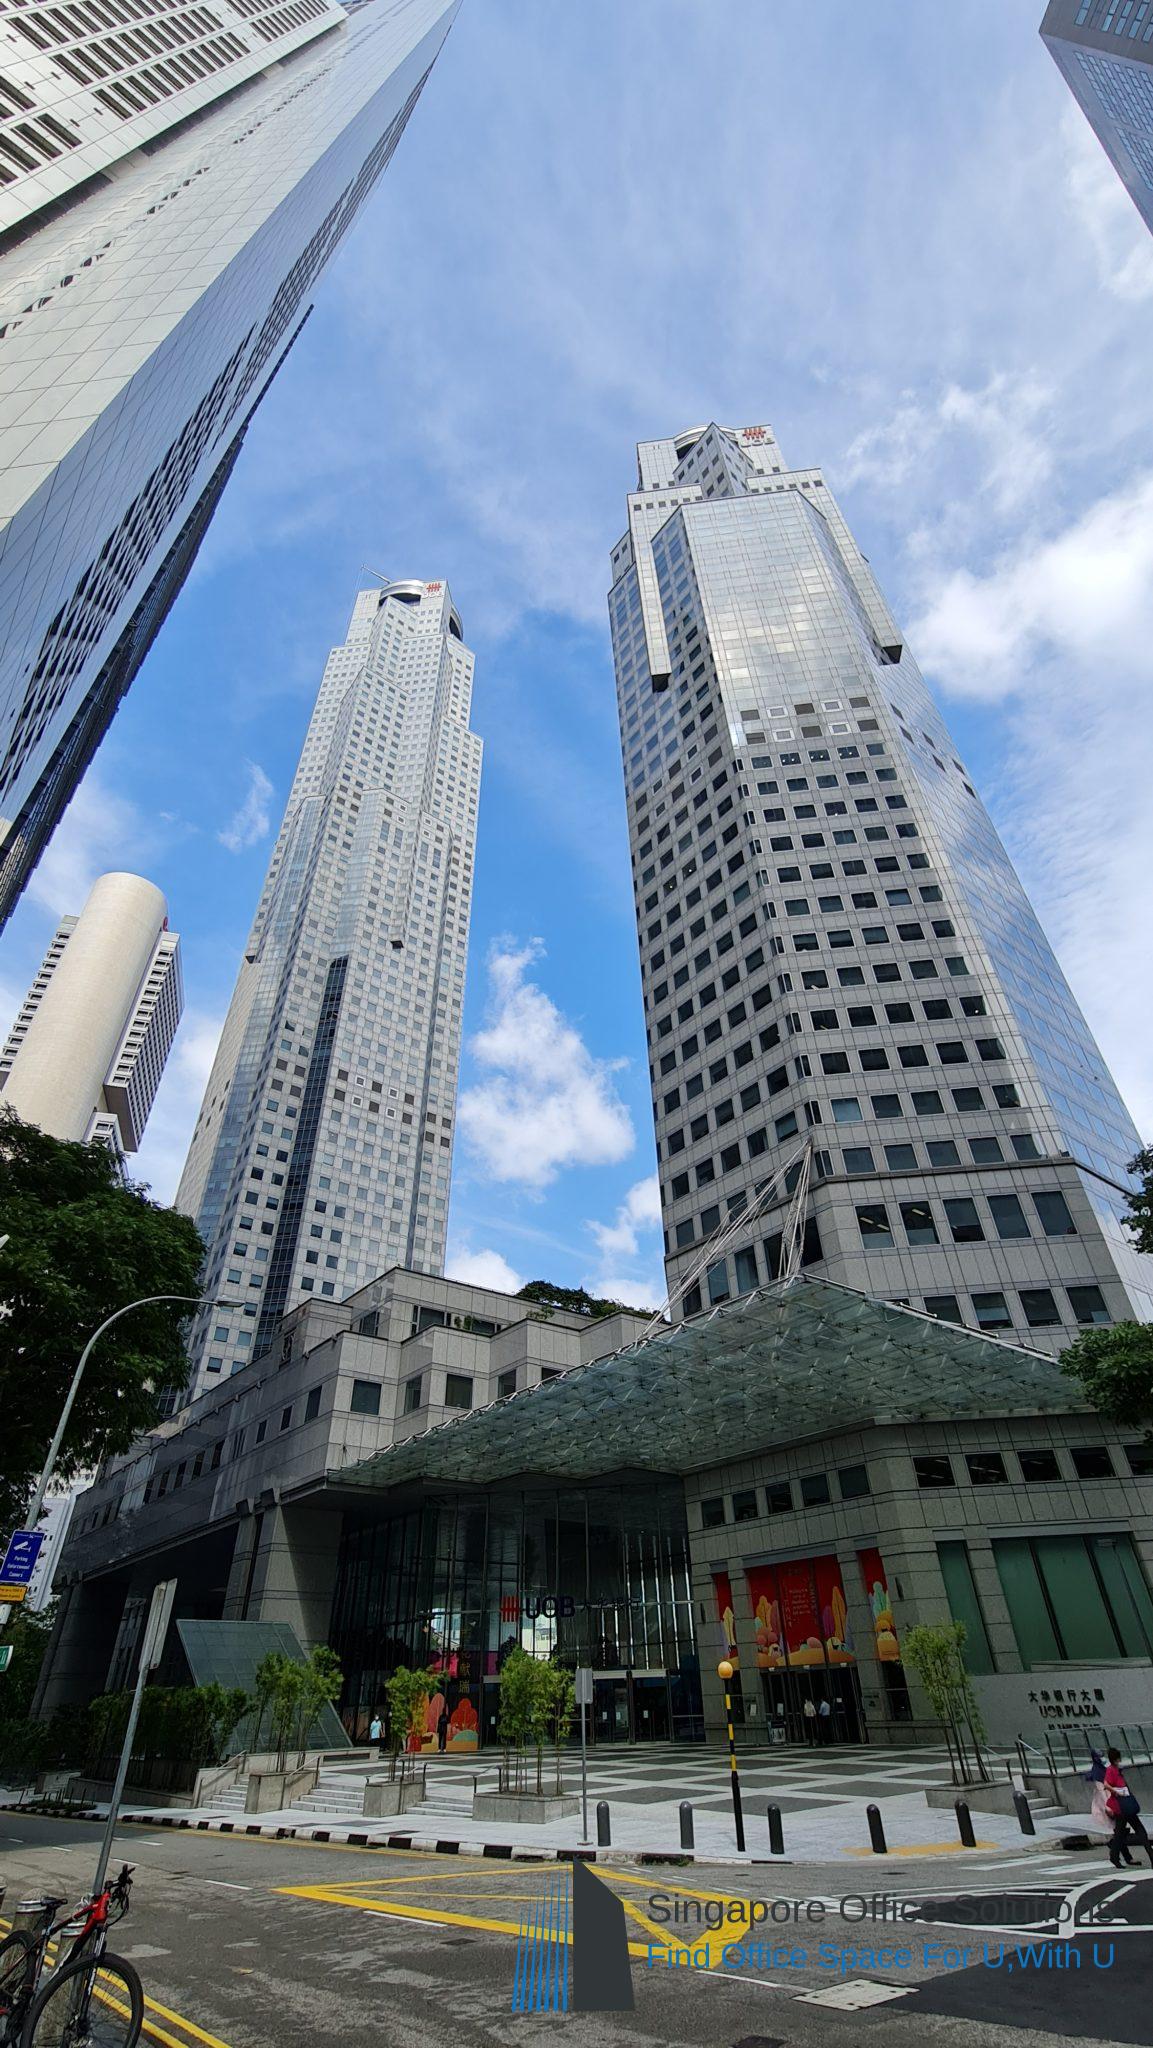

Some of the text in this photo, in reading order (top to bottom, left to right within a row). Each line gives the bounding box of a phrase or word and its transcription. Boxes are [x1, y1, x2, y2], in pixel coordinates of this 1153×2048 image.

[525, 1596, 575, 1619] UOB
[1039, 1704, 1101, 1718] UOB PLAZA
